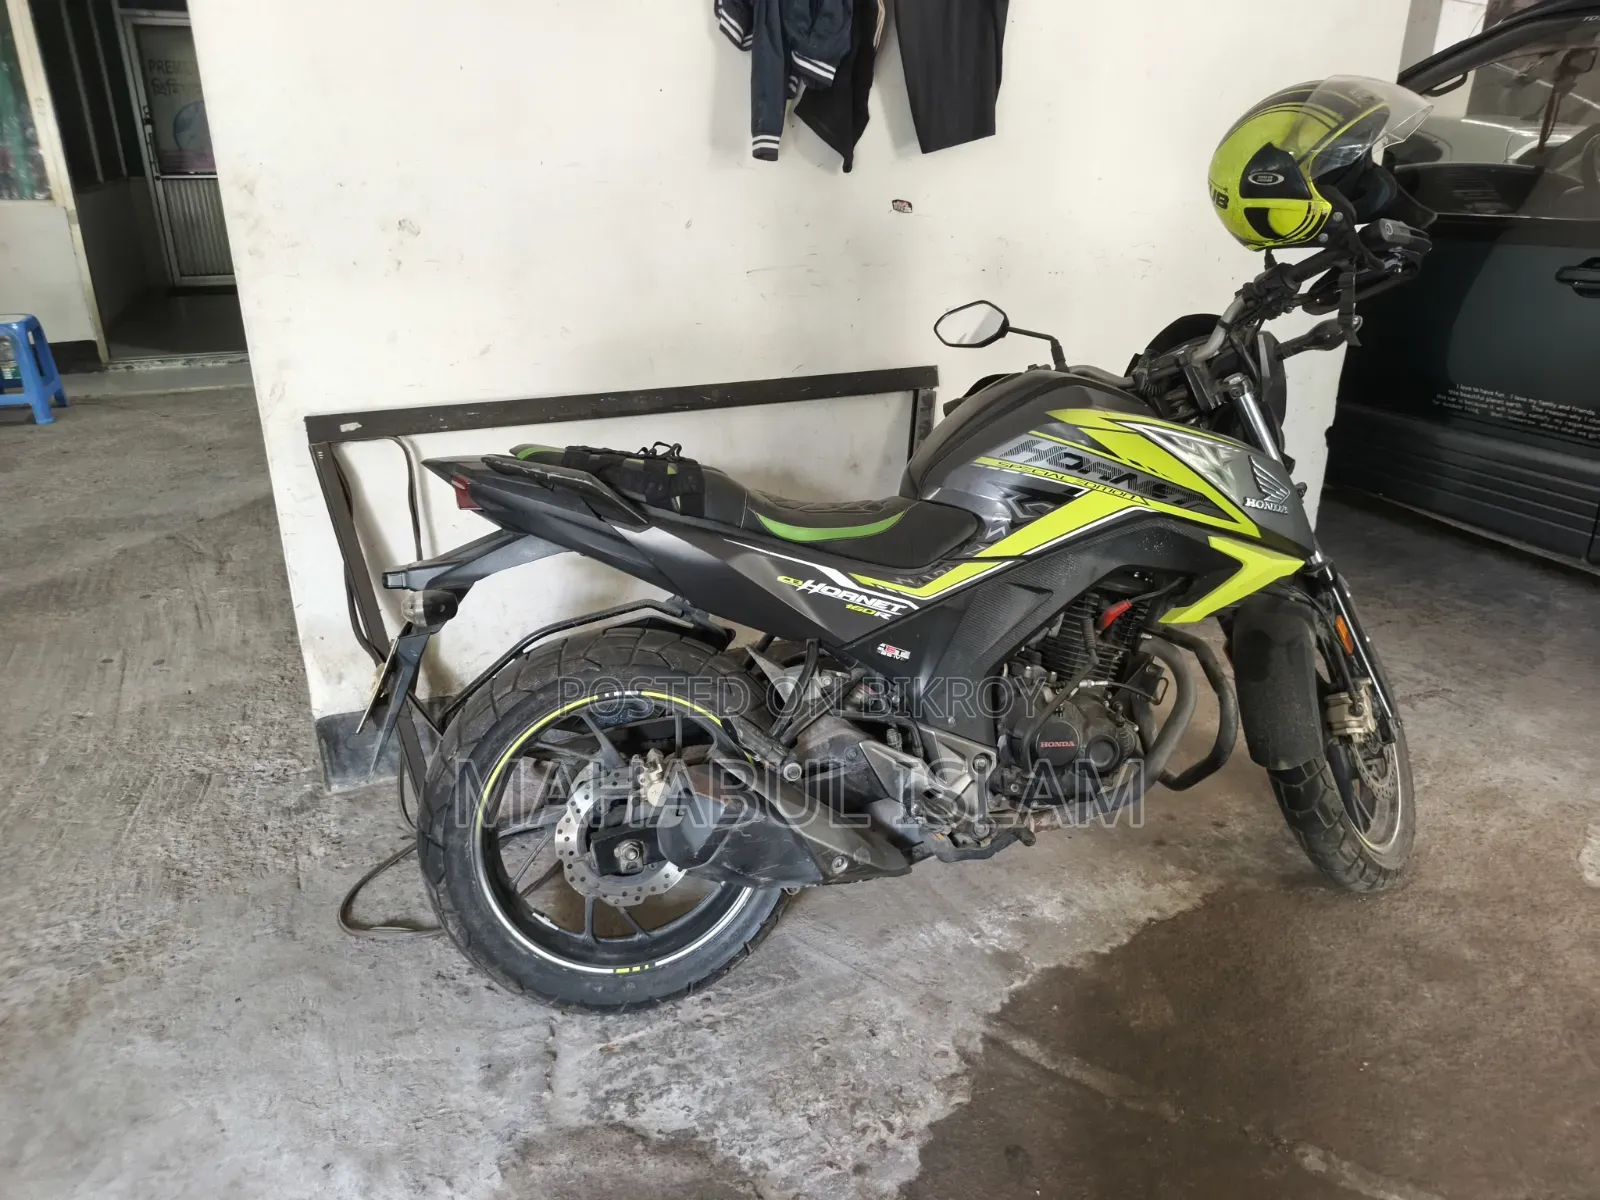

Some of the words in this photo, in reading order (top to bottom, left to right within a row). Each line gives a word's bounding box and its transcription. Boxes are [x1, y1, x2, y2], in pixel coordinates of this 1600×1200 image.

[1245, 497, 1288, 514] HONDA
[796, 579, 908, 613] HORNET
[846, 603, 892, 620] 160R
[1040, 740, 1076, 748] HONDA
